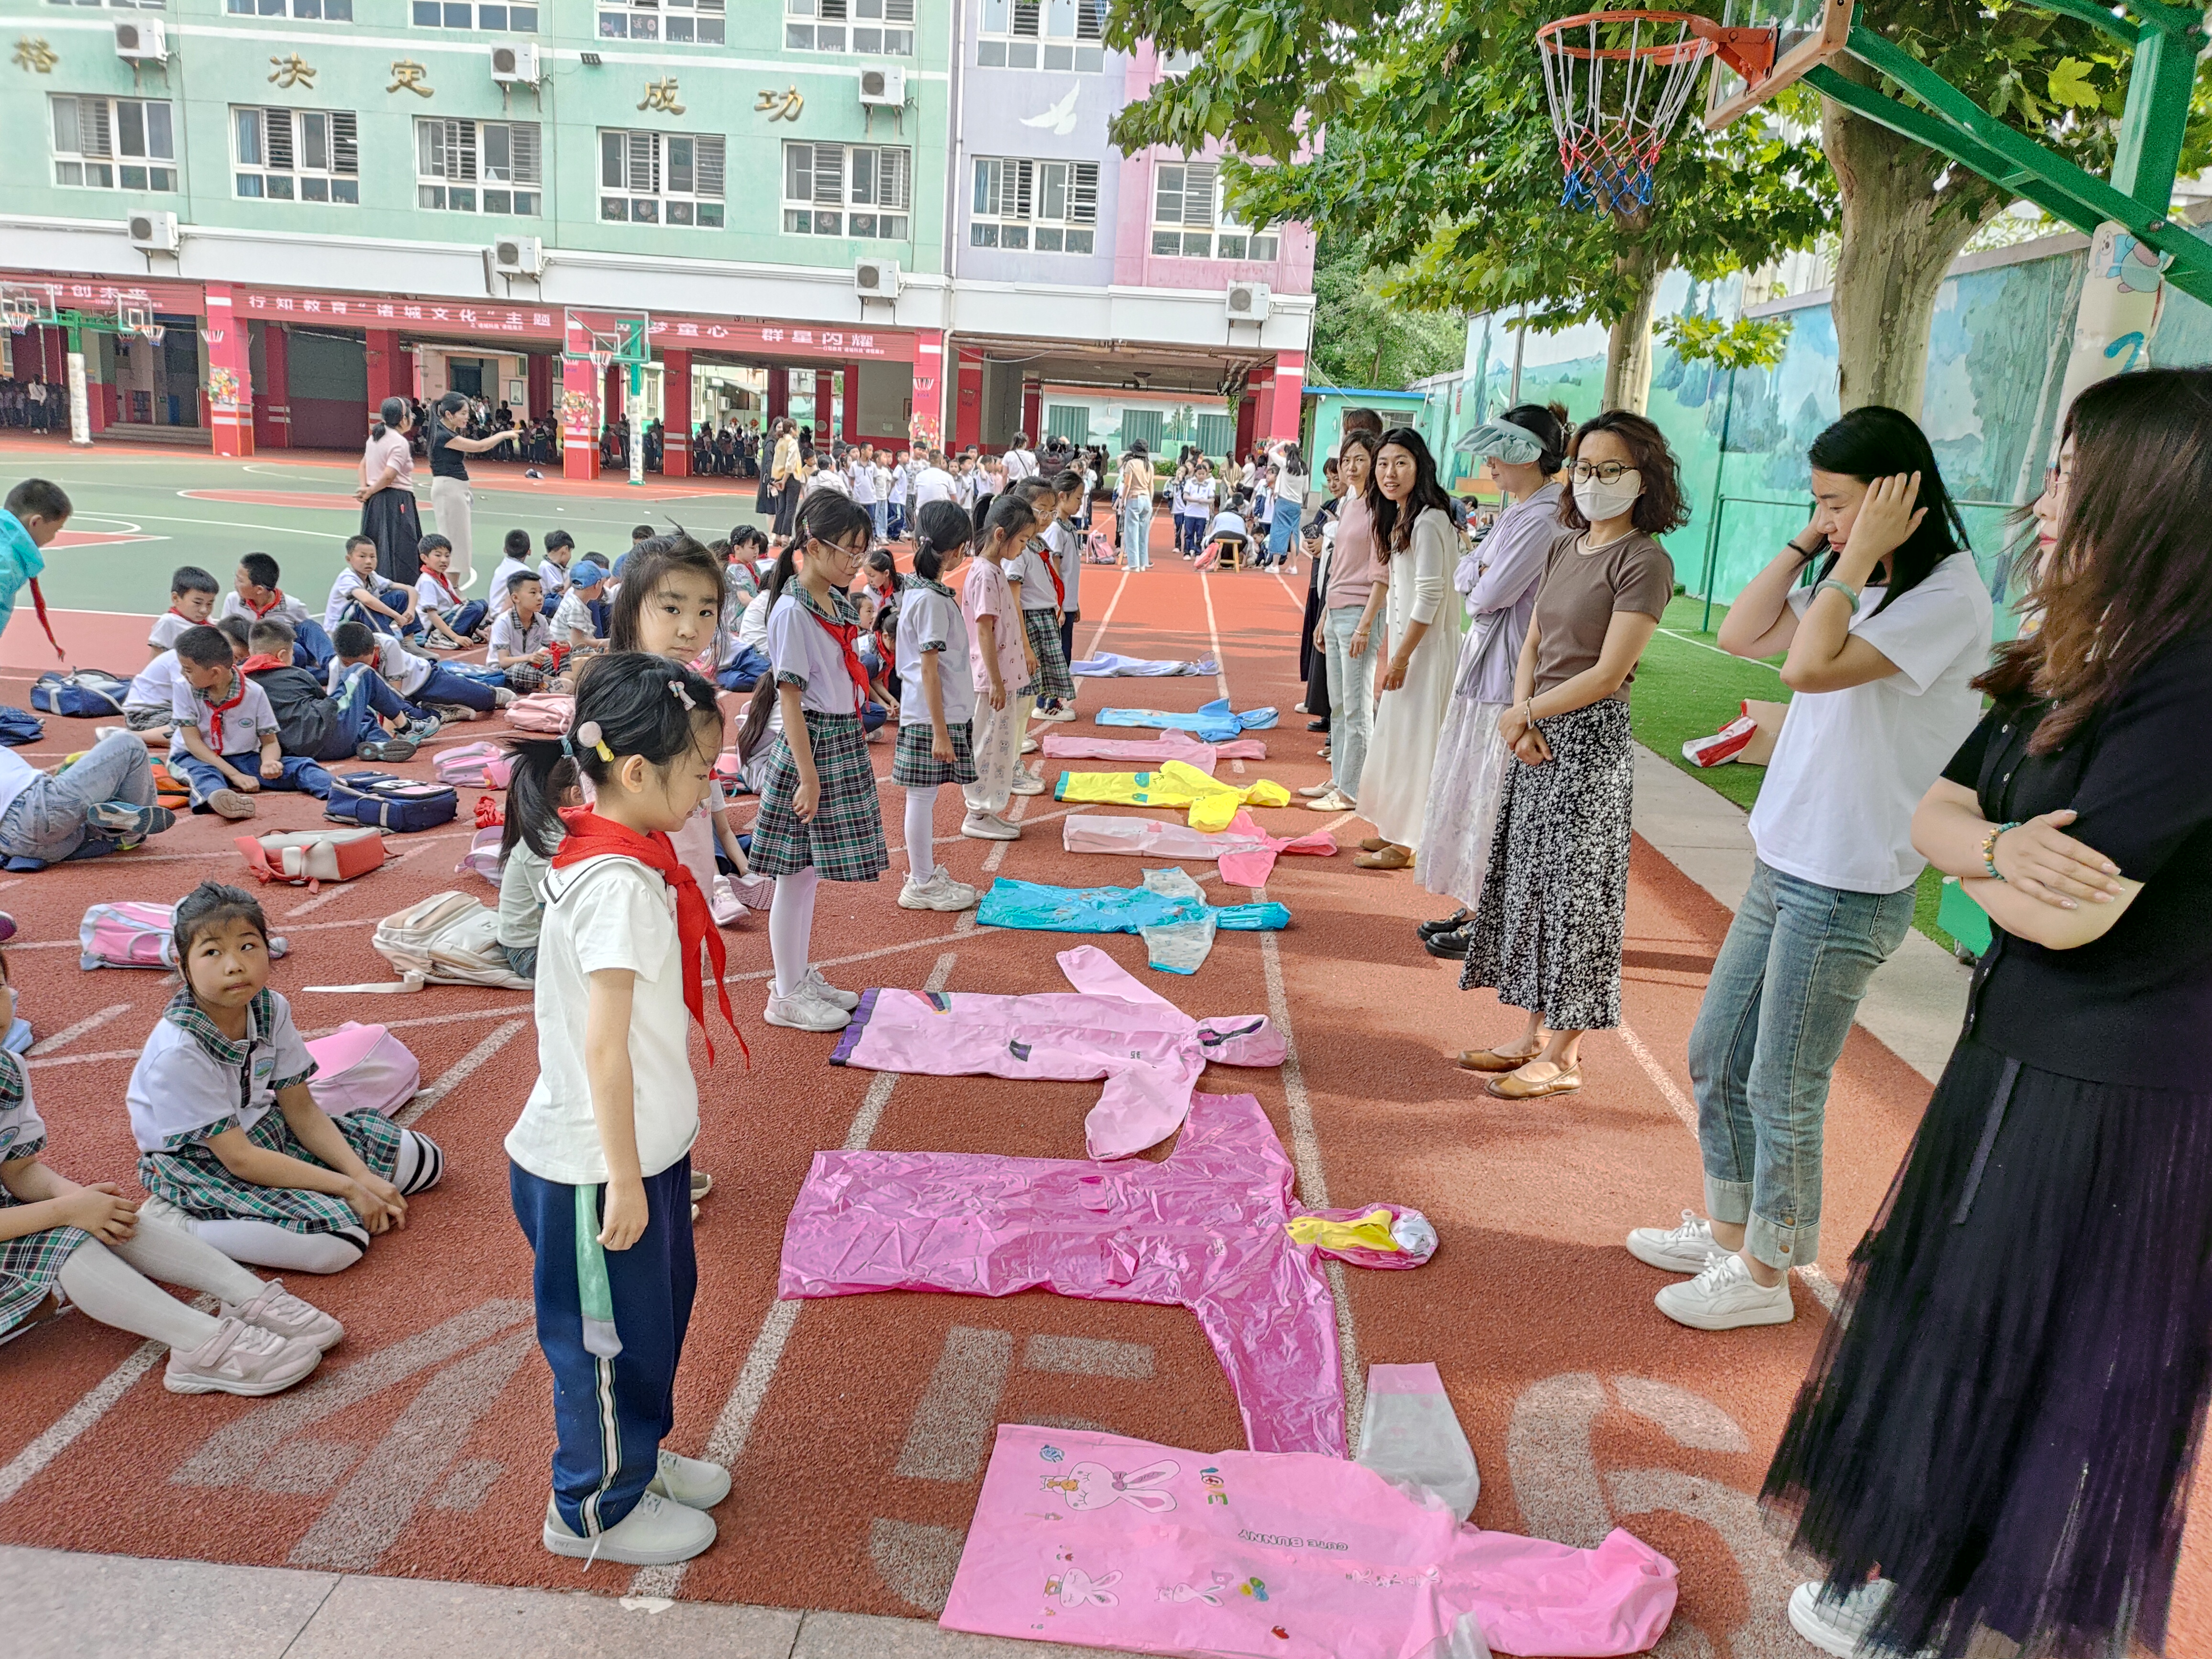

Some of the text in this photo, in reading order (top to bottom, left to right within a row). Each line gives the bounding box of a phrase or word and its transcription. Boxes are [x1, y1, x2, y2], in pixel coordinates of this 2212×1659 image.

[12, 35, 59, 73] 格
[762, 328, 873, 347] 群星闪耀
[1199, 1467, 1228, 1505] LOVE
[1238, 1529, 1348, 1550] CUTE BUNNY
